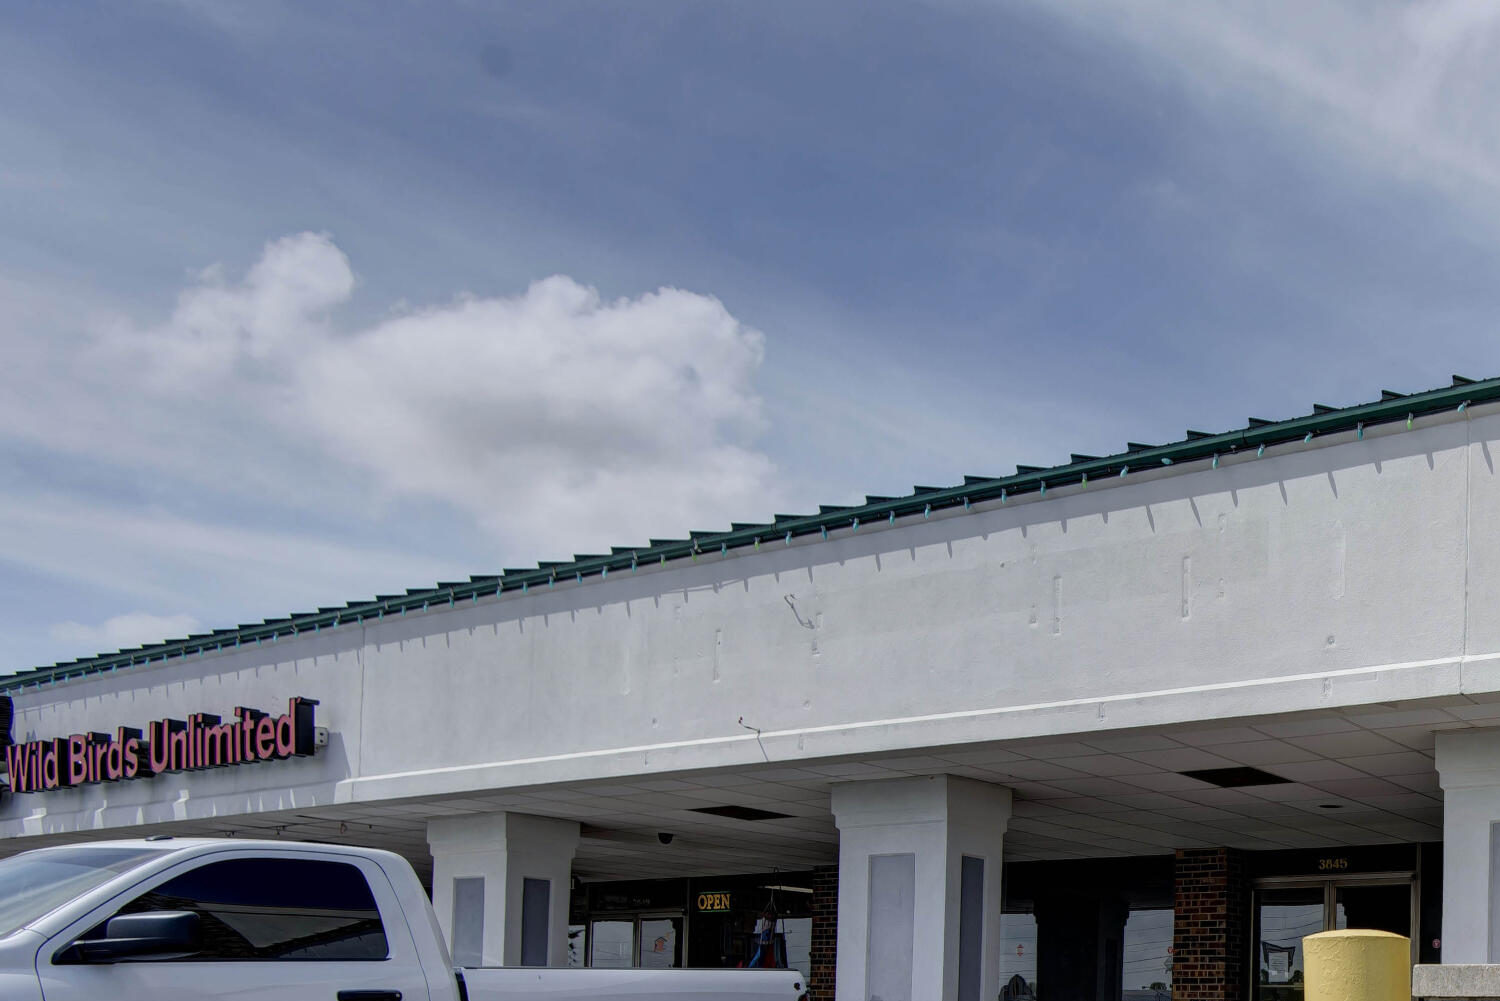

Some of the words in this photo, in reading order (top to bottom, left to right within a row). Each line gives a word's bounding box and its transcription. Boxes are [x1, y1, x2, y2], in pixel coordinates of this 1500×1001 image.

[6, 737, 60, 793] Wild
[68, 725, 139, 786] Birds
[149, 696, 297, 774] Unlimited
[1319, 858, 1348, 870] 3845
[698, 893, 730, 910] OPEN
